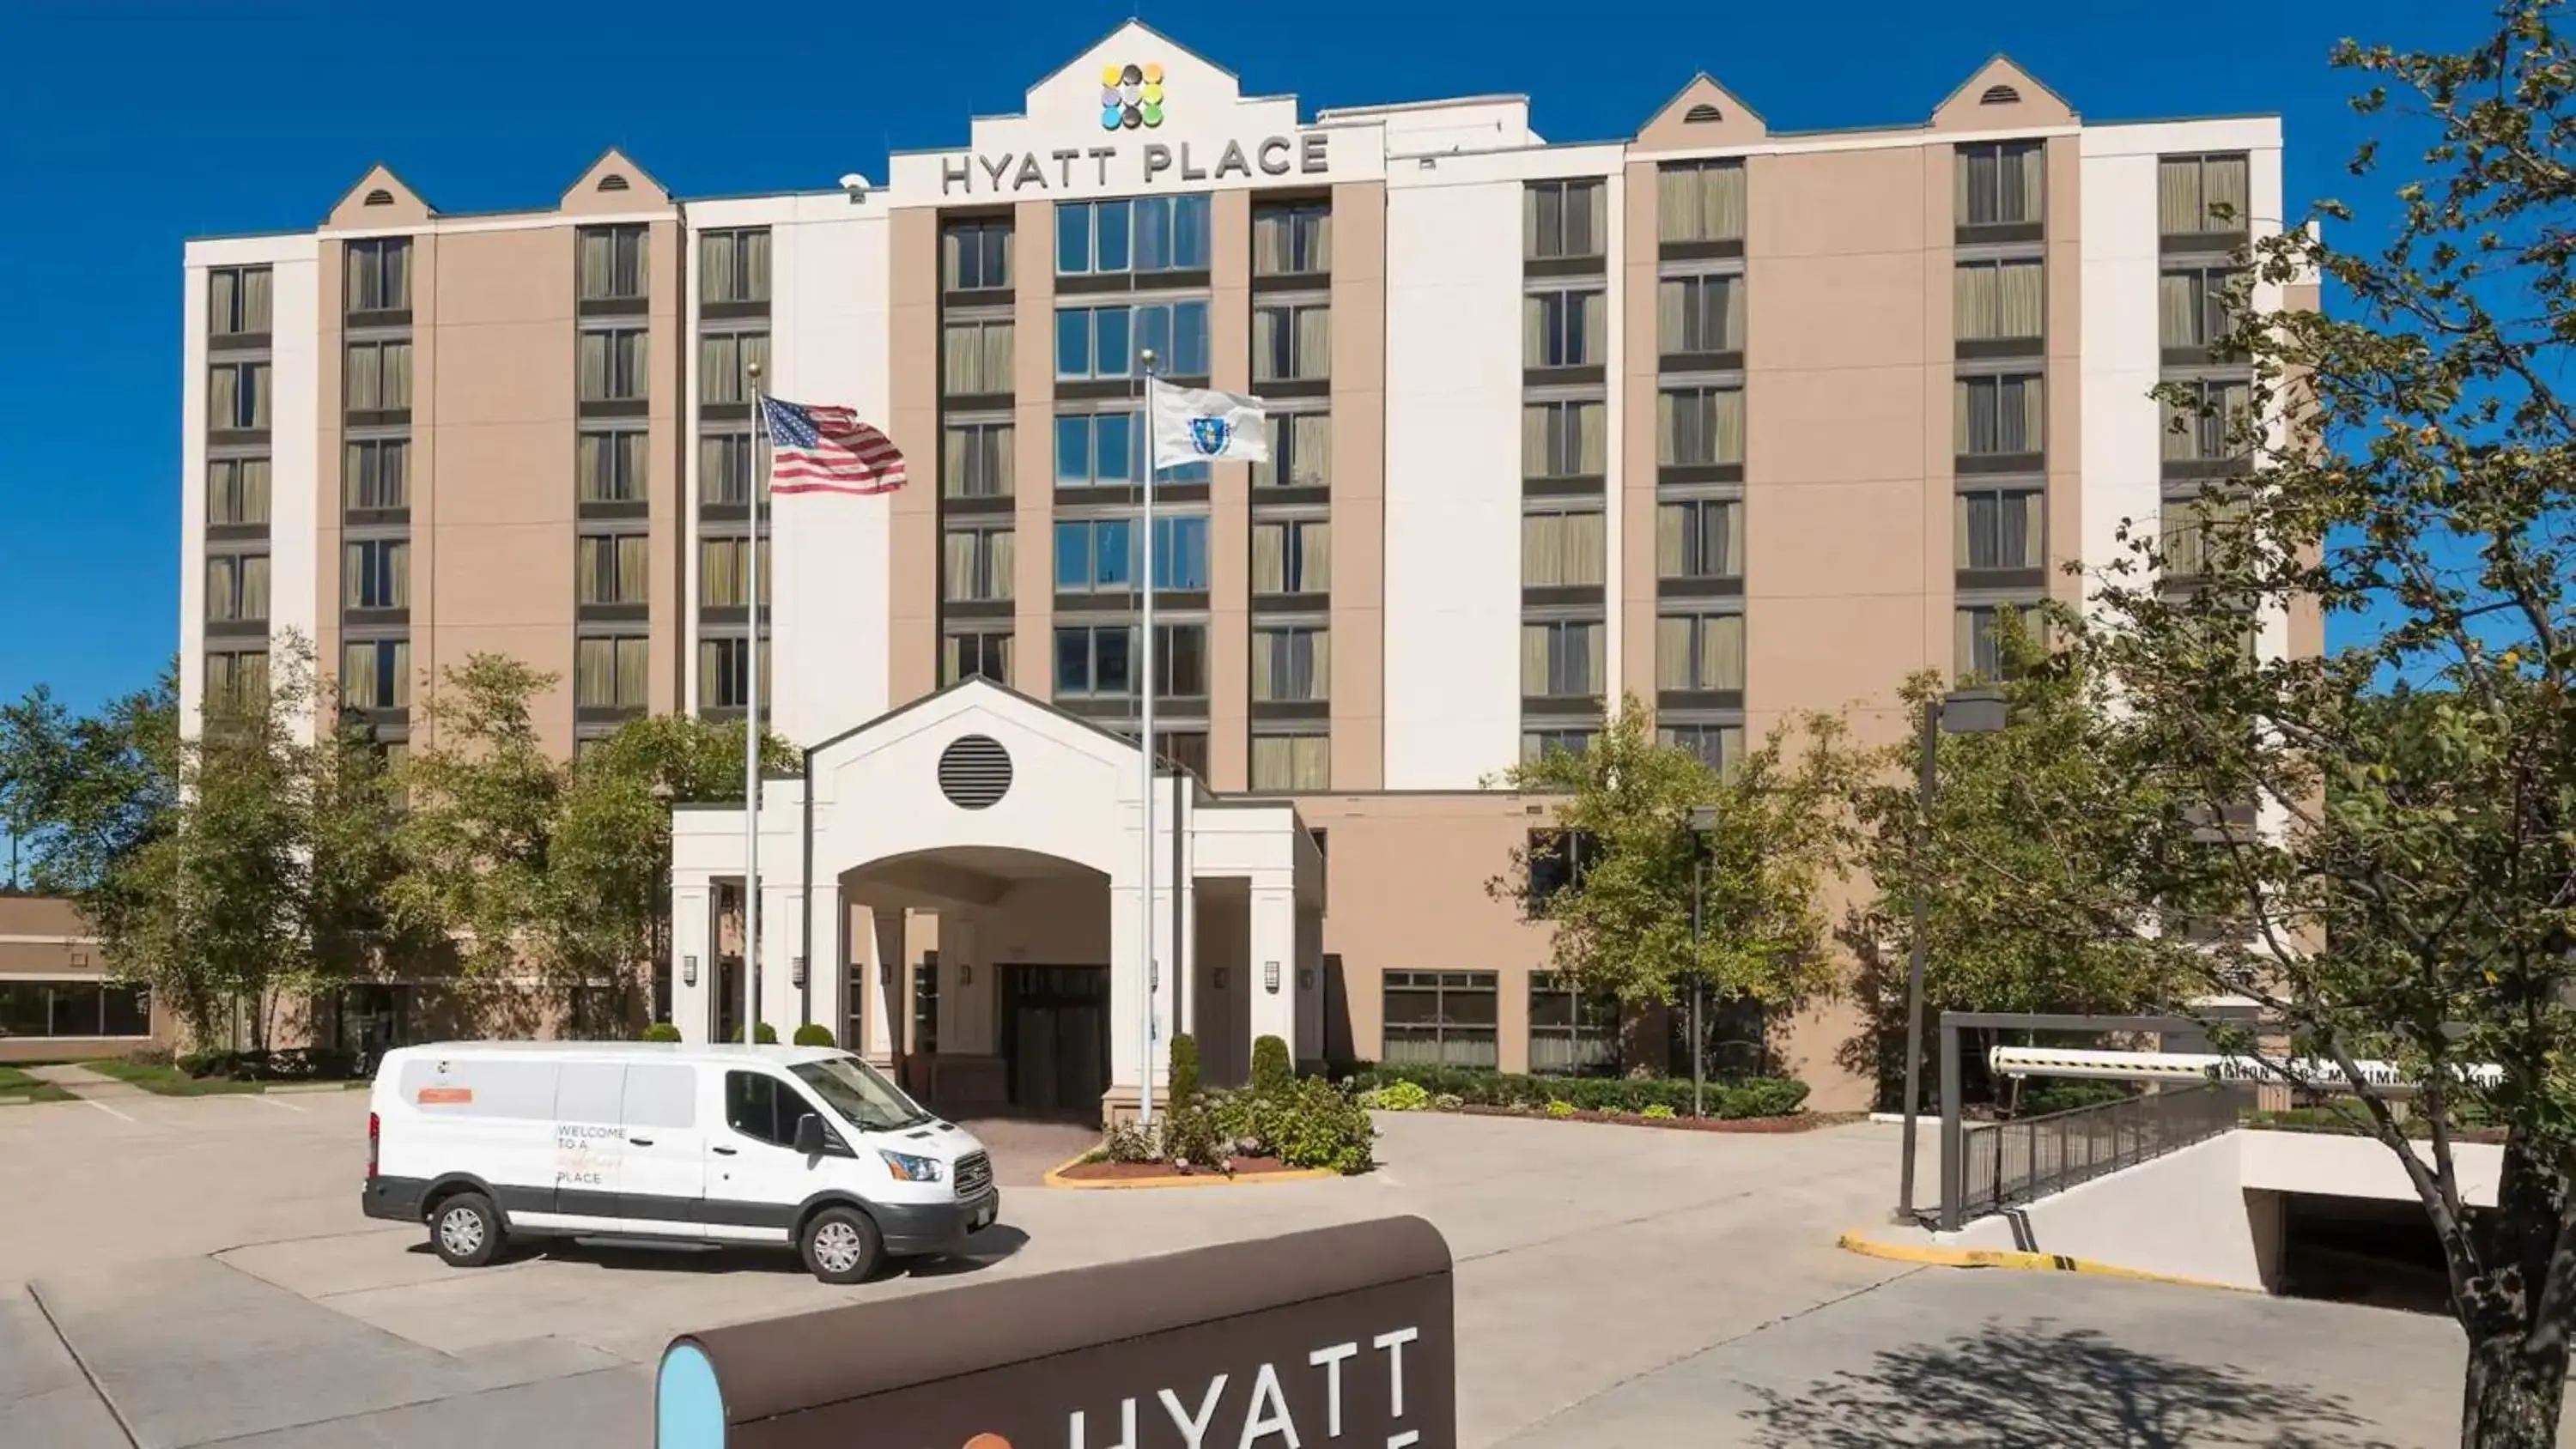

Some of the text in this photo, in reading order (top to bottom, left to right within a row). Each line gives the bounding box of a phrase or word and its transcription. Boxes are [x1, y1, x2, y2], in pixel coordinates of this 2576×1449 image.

[941, 133, 1329, 195] HYATT PLACE
[558, 1125, 627, 1139] WELCOME
[558, 1137, 589, 1150] TO A
[556, 1172, 603, 1185] PLACE
[1069, 1326, 1419, 1449] HYATT
